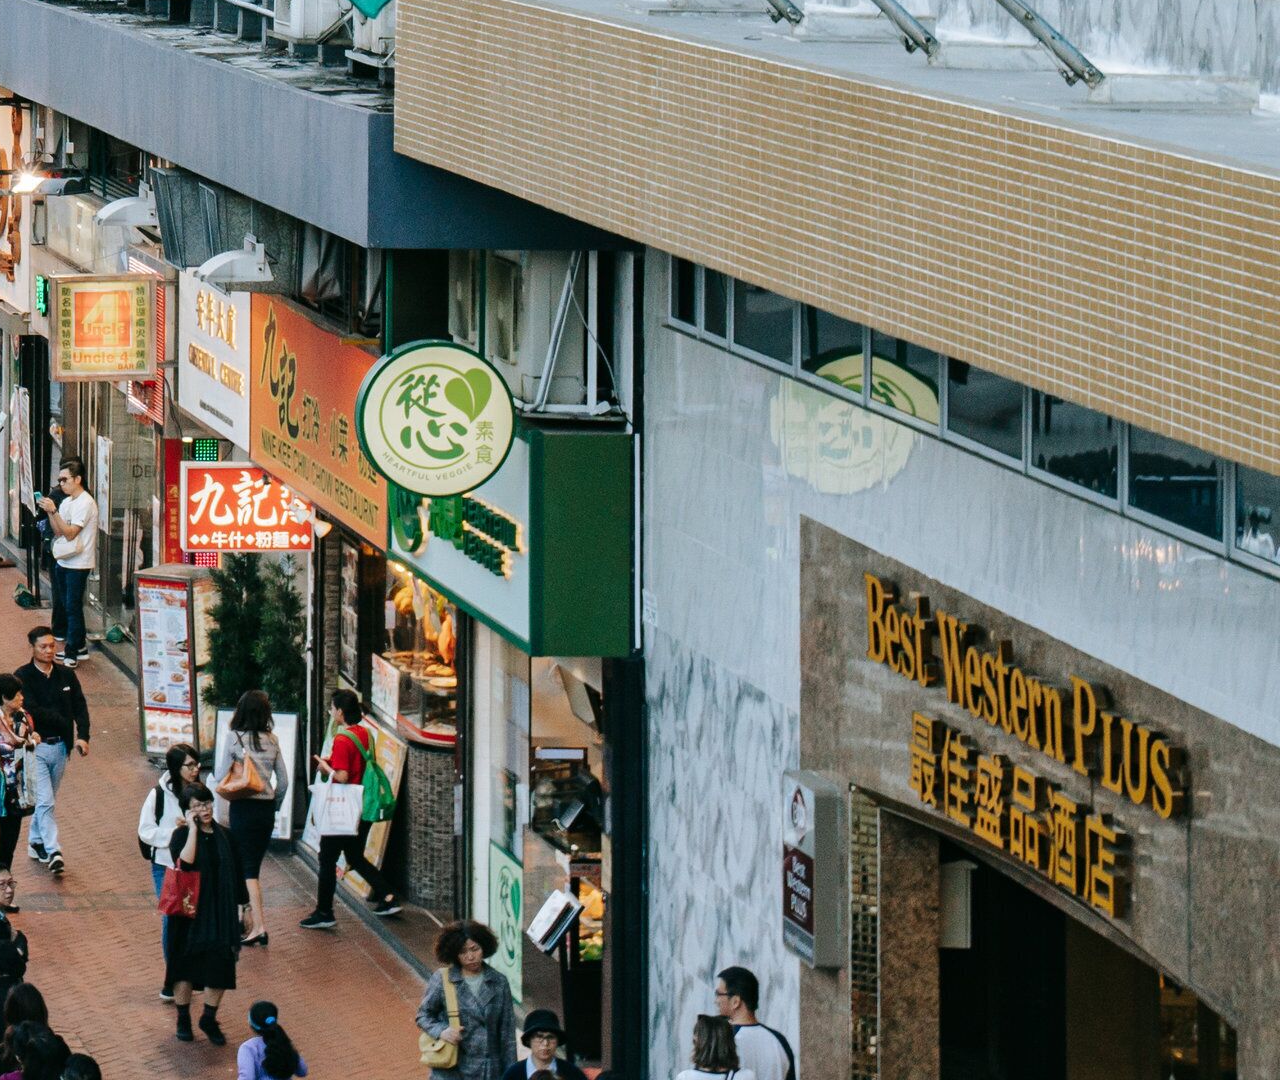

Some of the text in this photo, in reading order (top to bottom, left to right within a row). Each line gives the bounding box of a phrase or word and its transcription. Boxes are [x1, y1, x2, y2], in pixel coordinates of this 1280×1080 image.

[73, 352, 115, 364] Uncle
[261, 426, 277, 458] NINE
[278, 435, 292, 469] KEE
[474, 420, 495, 466] 素食
[382, 451, 430, 482] HEARTFUL
[435, 463, 474, 482] VEGGIE
[211, 530, 245, 549] 牛什
[863, 572, 937, 688] Best
[936, 610, 1067, 772] Western
